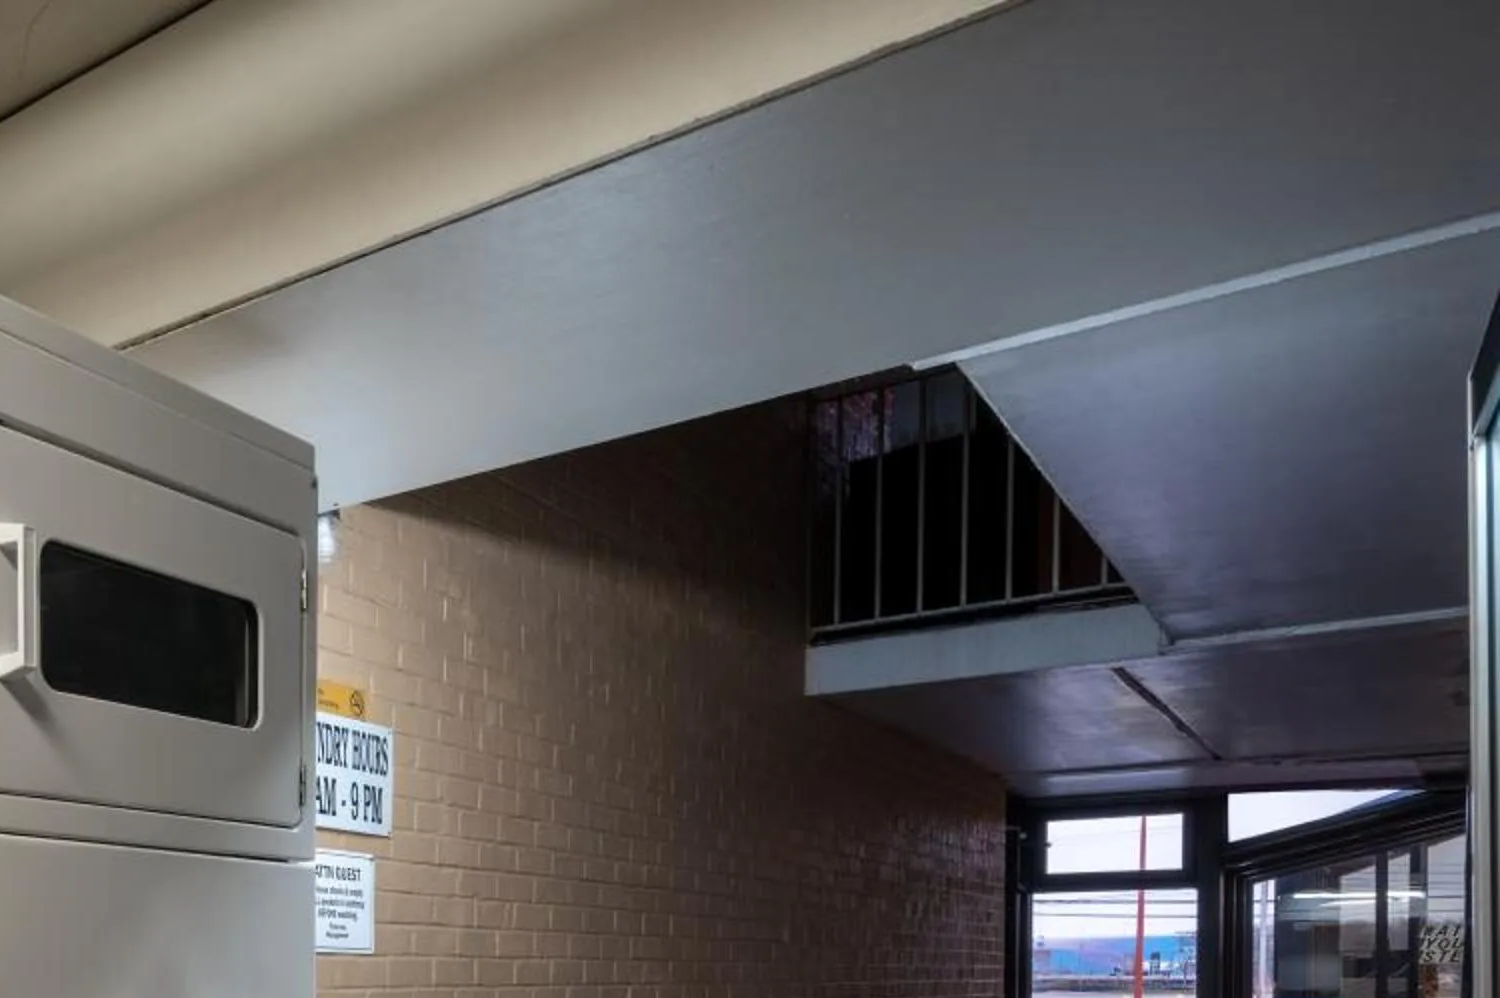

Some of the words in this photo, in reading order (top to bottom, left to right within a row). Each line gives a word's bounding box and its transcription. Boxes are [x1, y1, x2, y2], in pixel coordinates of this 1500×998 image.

[316, 722, 349, 768] NDRY
[351, 729, 390, 777] HOURS
[315, 776, 337, 817] AM
[350, 781, 360, 821] 9
[363, 783, 384, 825] PM
[1423, 950, 1461, 963] STE
